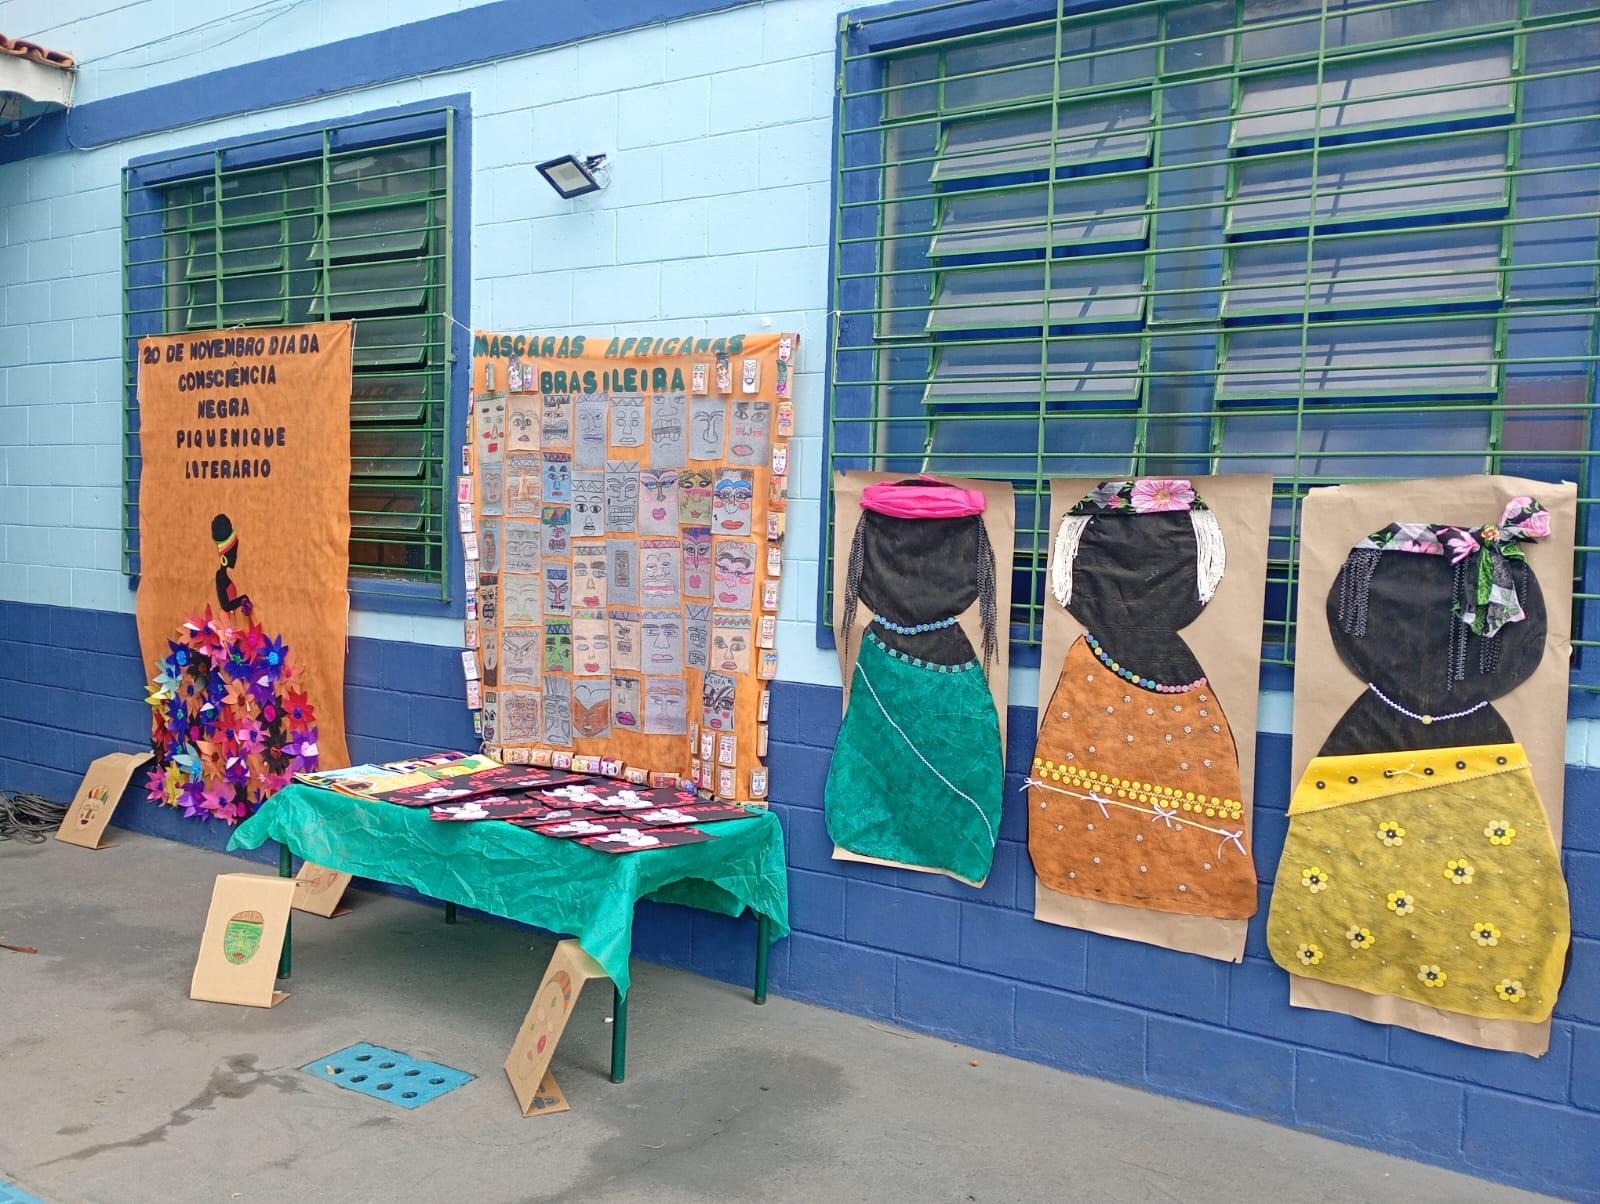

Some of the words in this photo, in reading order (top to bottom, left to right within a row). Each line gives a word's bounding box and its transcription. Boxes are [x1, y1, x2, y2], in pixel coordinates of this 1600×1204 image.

[144, 345, 160, 364] 20
[166, 343, 184, 362] DE
[190, 337, 264, 360] NOVEMBRO
[268, 334, 295, 355] DIA
[299, 333, 319, 353] DA
[473, 334, 586, 358] MASCARAS
[604, 333, 746, 357] AFRICANAS
[178, 361, 276, 392] CONSCIÊNCIA
[540, 367, 686, 395] BRASILEIRA
[197, 397, 249, 419] NEGRA
[176, 427, 286, 448] PIQUENIQUE
[185, 455, 271, 479] LITERÁRIO
